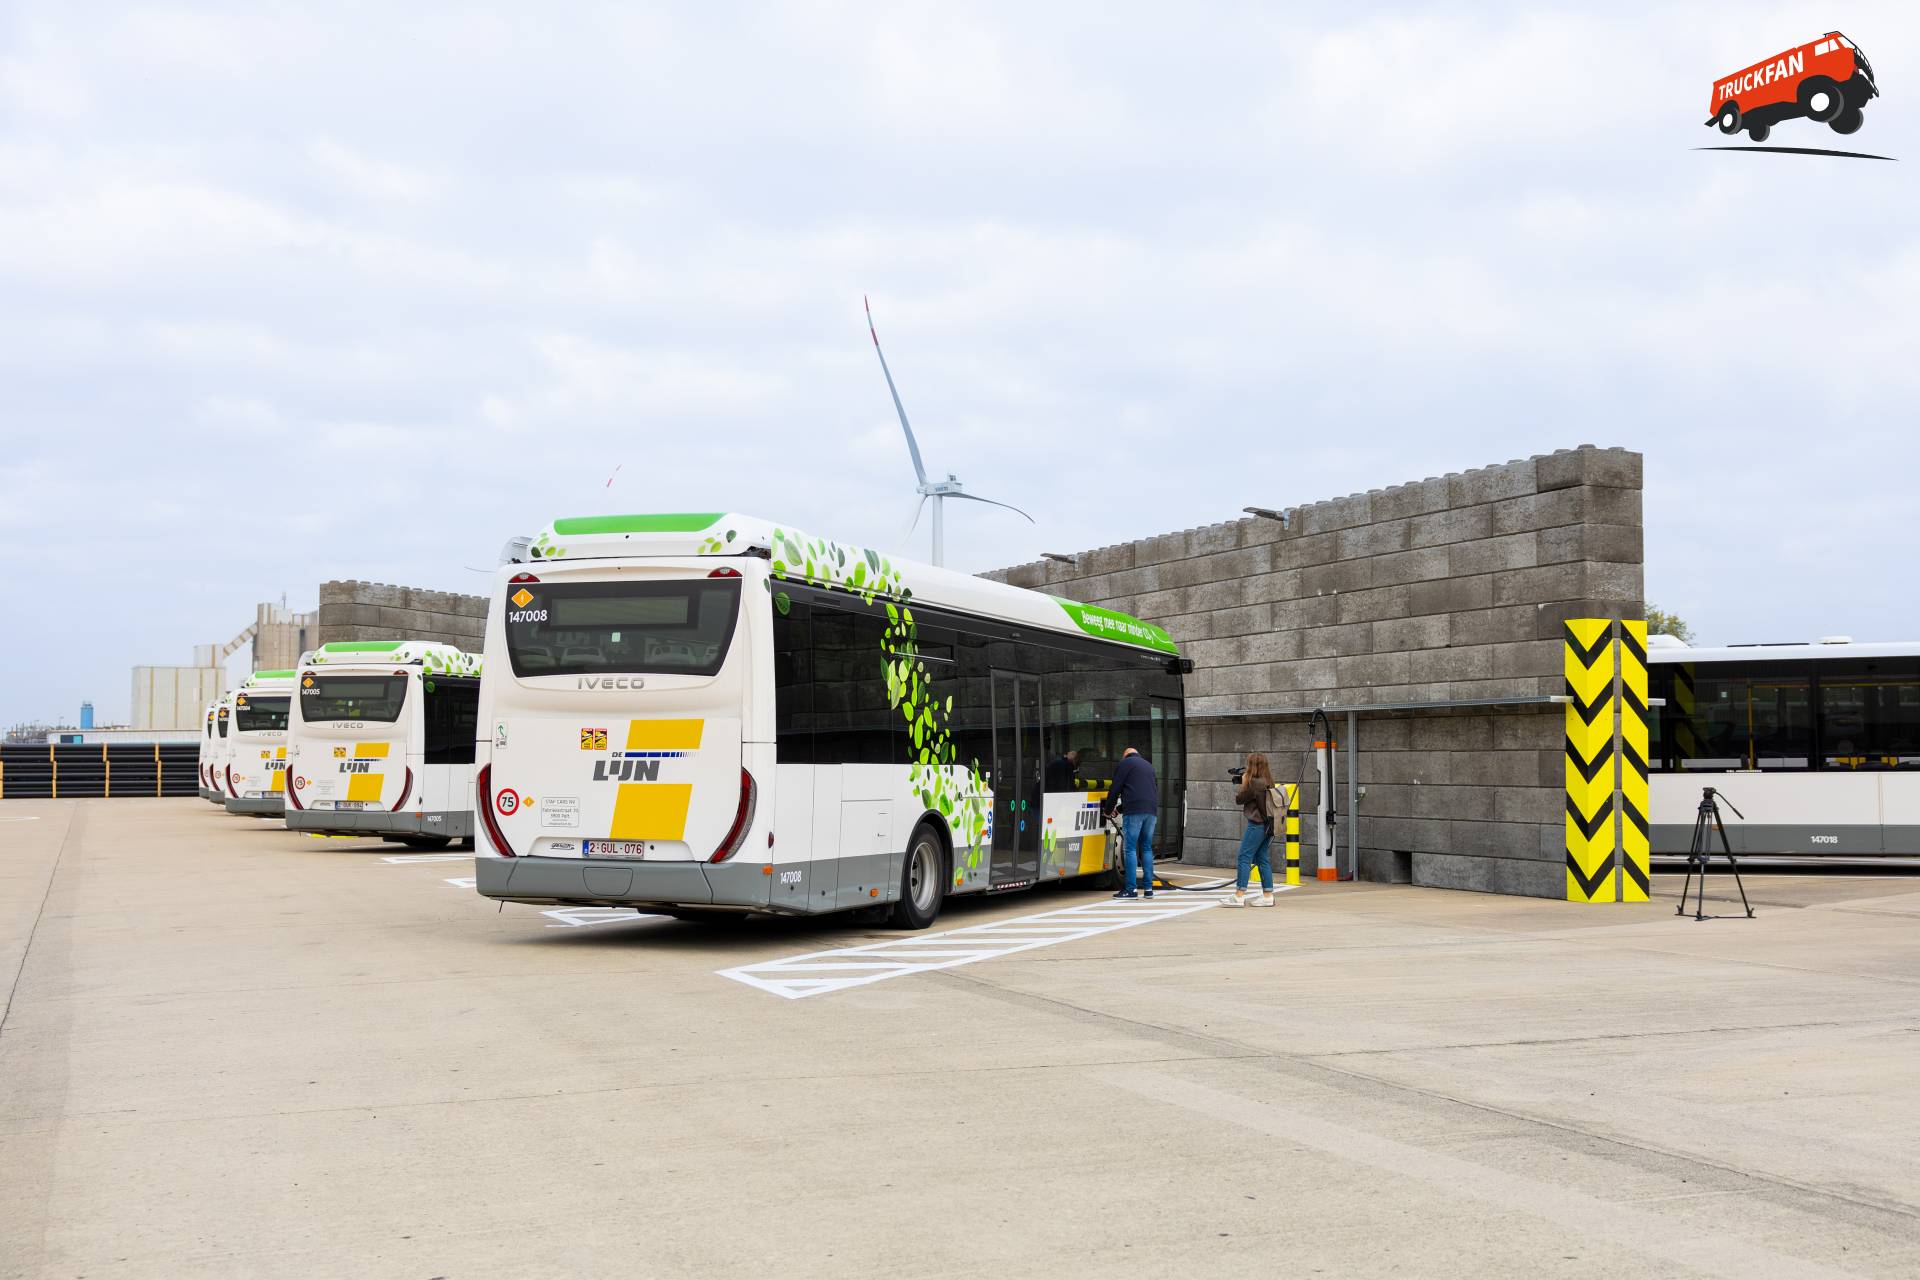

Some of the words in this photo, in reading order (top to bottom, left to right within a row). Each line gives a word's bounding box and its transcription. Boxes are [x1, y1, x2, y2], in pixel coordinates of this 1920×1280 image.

[508, 609, 548, 623] 147008
[577, 678, 645, 690] IVECO
[339, 762, 370, 773] LIJN
[593, 760, 660, 781] LIJN
[501, 796, 514, 808] 75
[1074, 810, 1098, 831] LIJN
[1811, 836, 1838, 844] 147018
[780, 870, 802, 885] 147008
